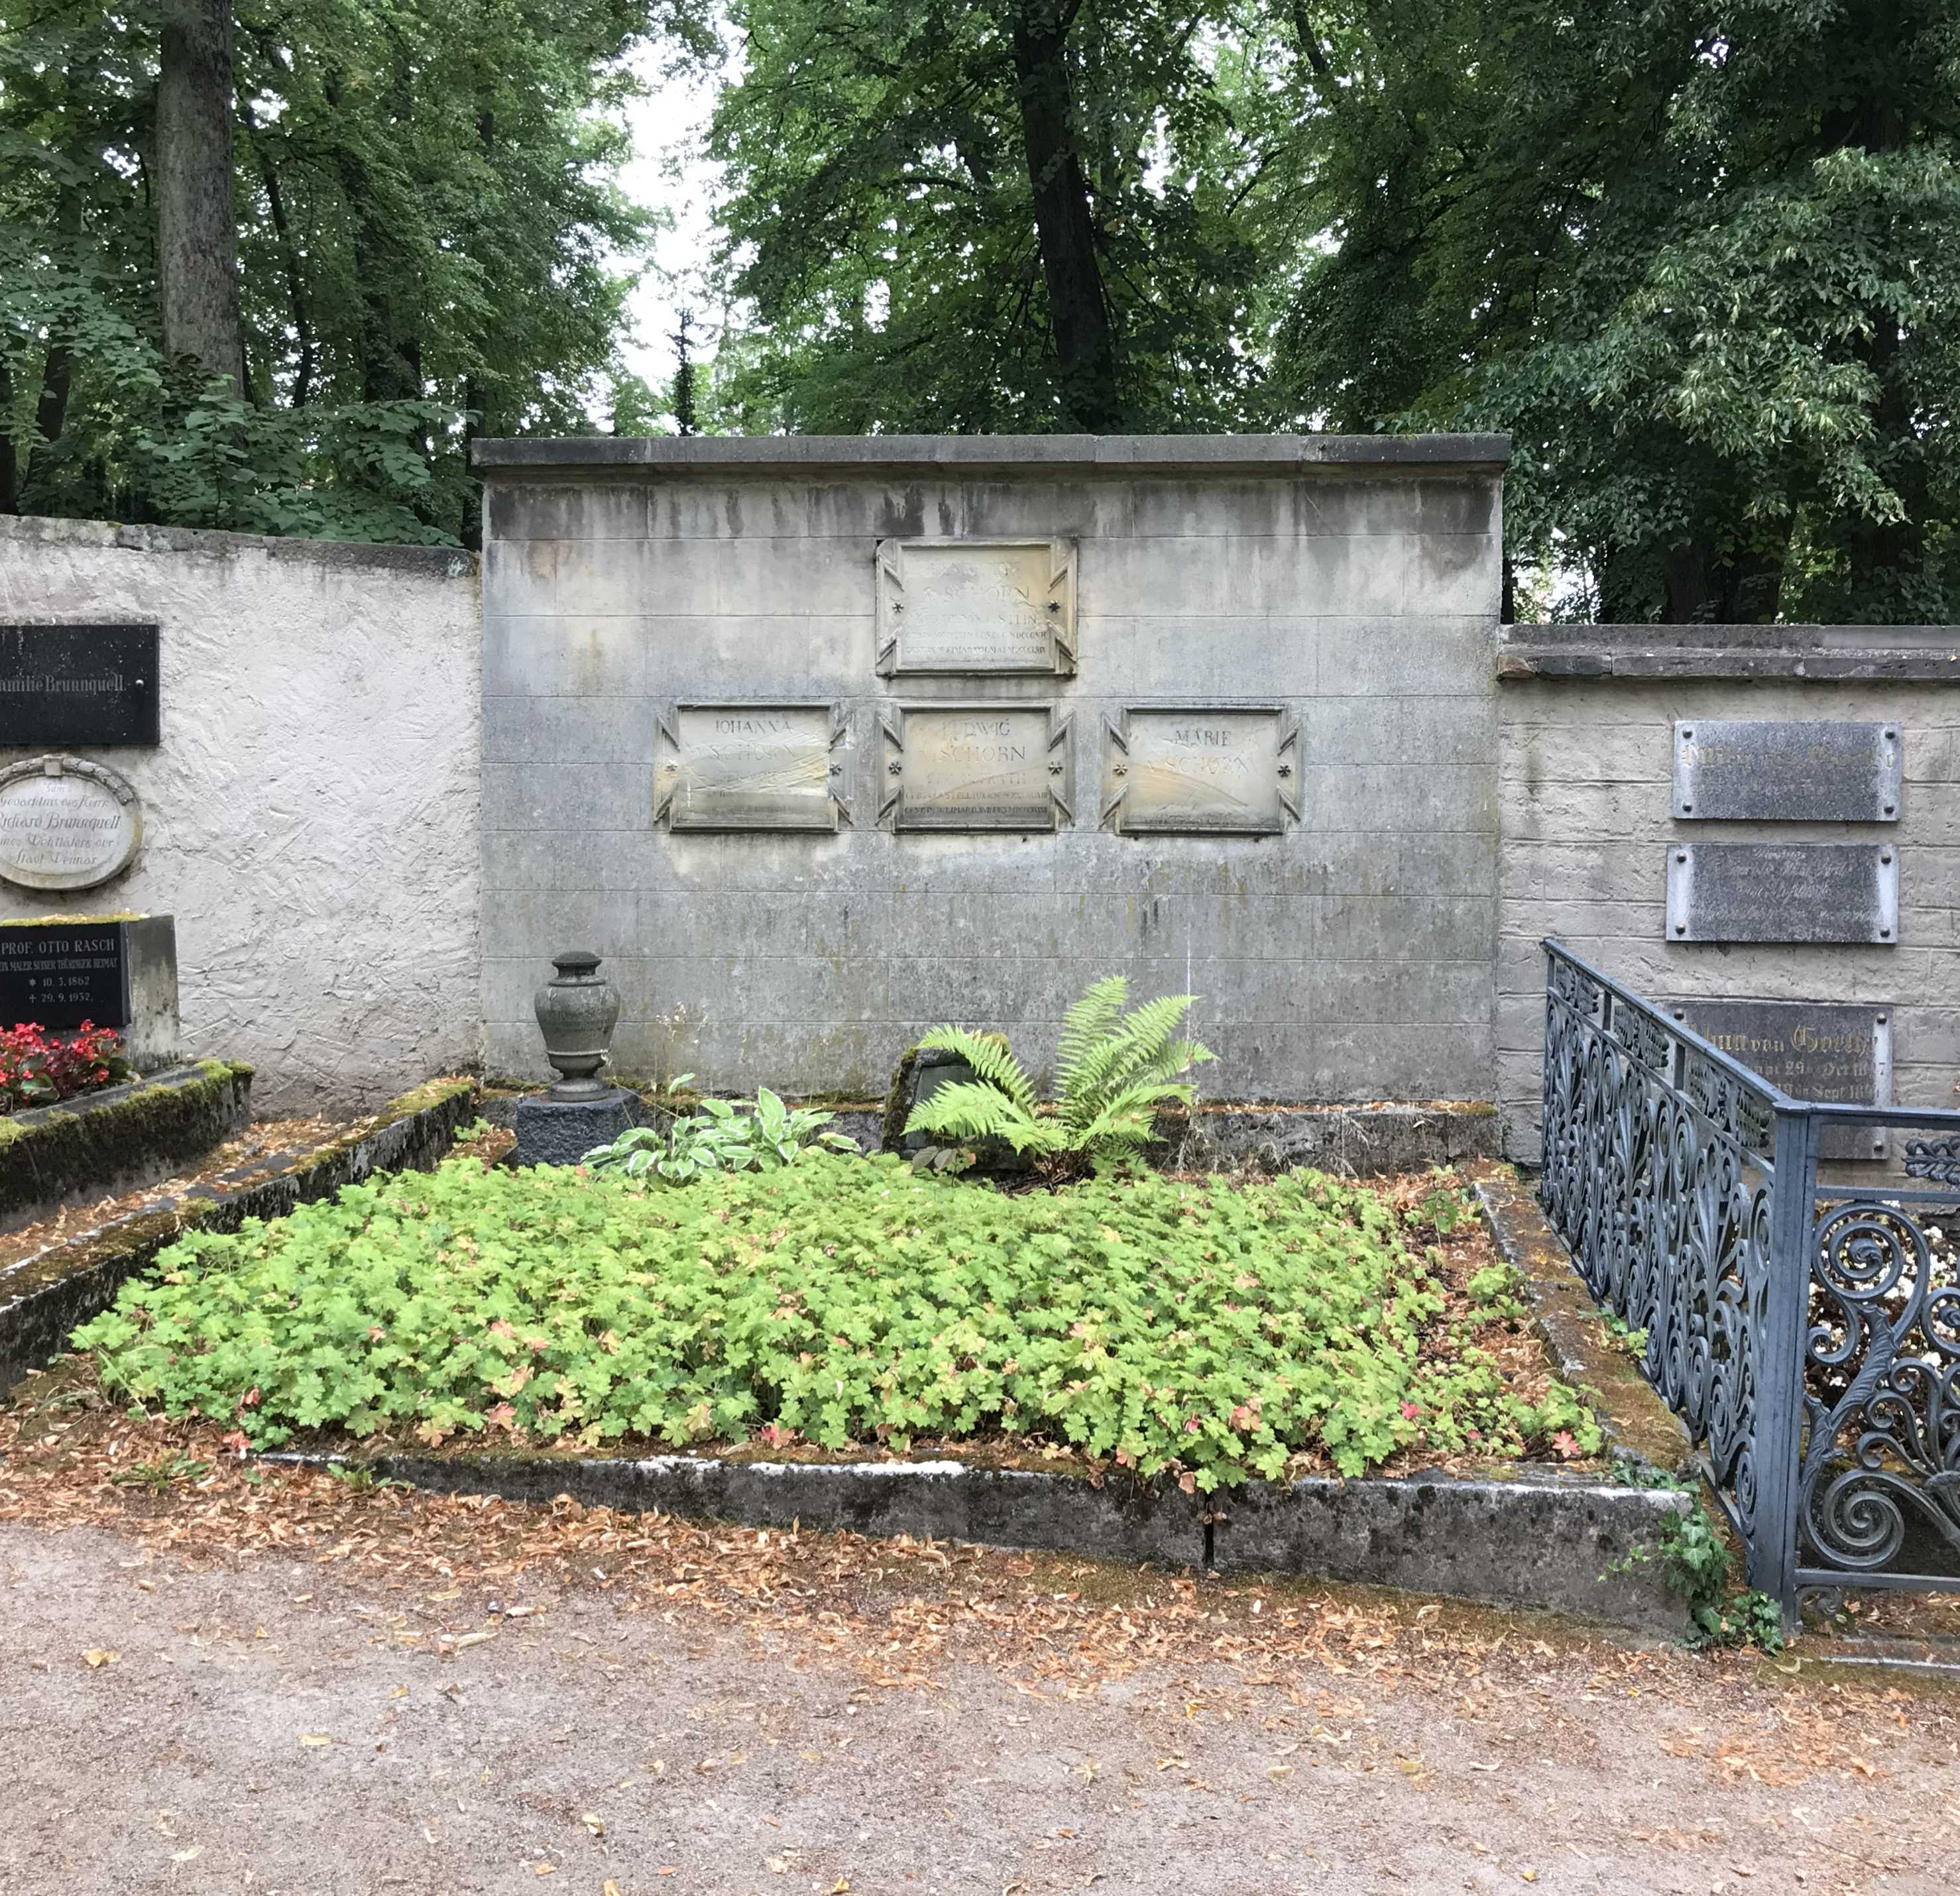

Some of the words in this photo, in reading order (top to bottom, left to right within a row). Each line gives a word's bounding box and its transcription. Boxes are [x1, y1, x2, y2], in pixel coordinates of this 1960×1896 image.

[1175, 730, 1232, 747] MARIE
[940, 746, 1026, 763] SCHORN
[44, 812, 121, 832] Brunnquell
[1, 942, 34, 955] PROF.
[38, 940, 70, 954] OTTO
[74, 938, 115, 953] RASCH
[9, 961, 32, 972] MALER
[33, 960, 56, 970] SEINER
[93, 958, 119, 969] HEIMAT
